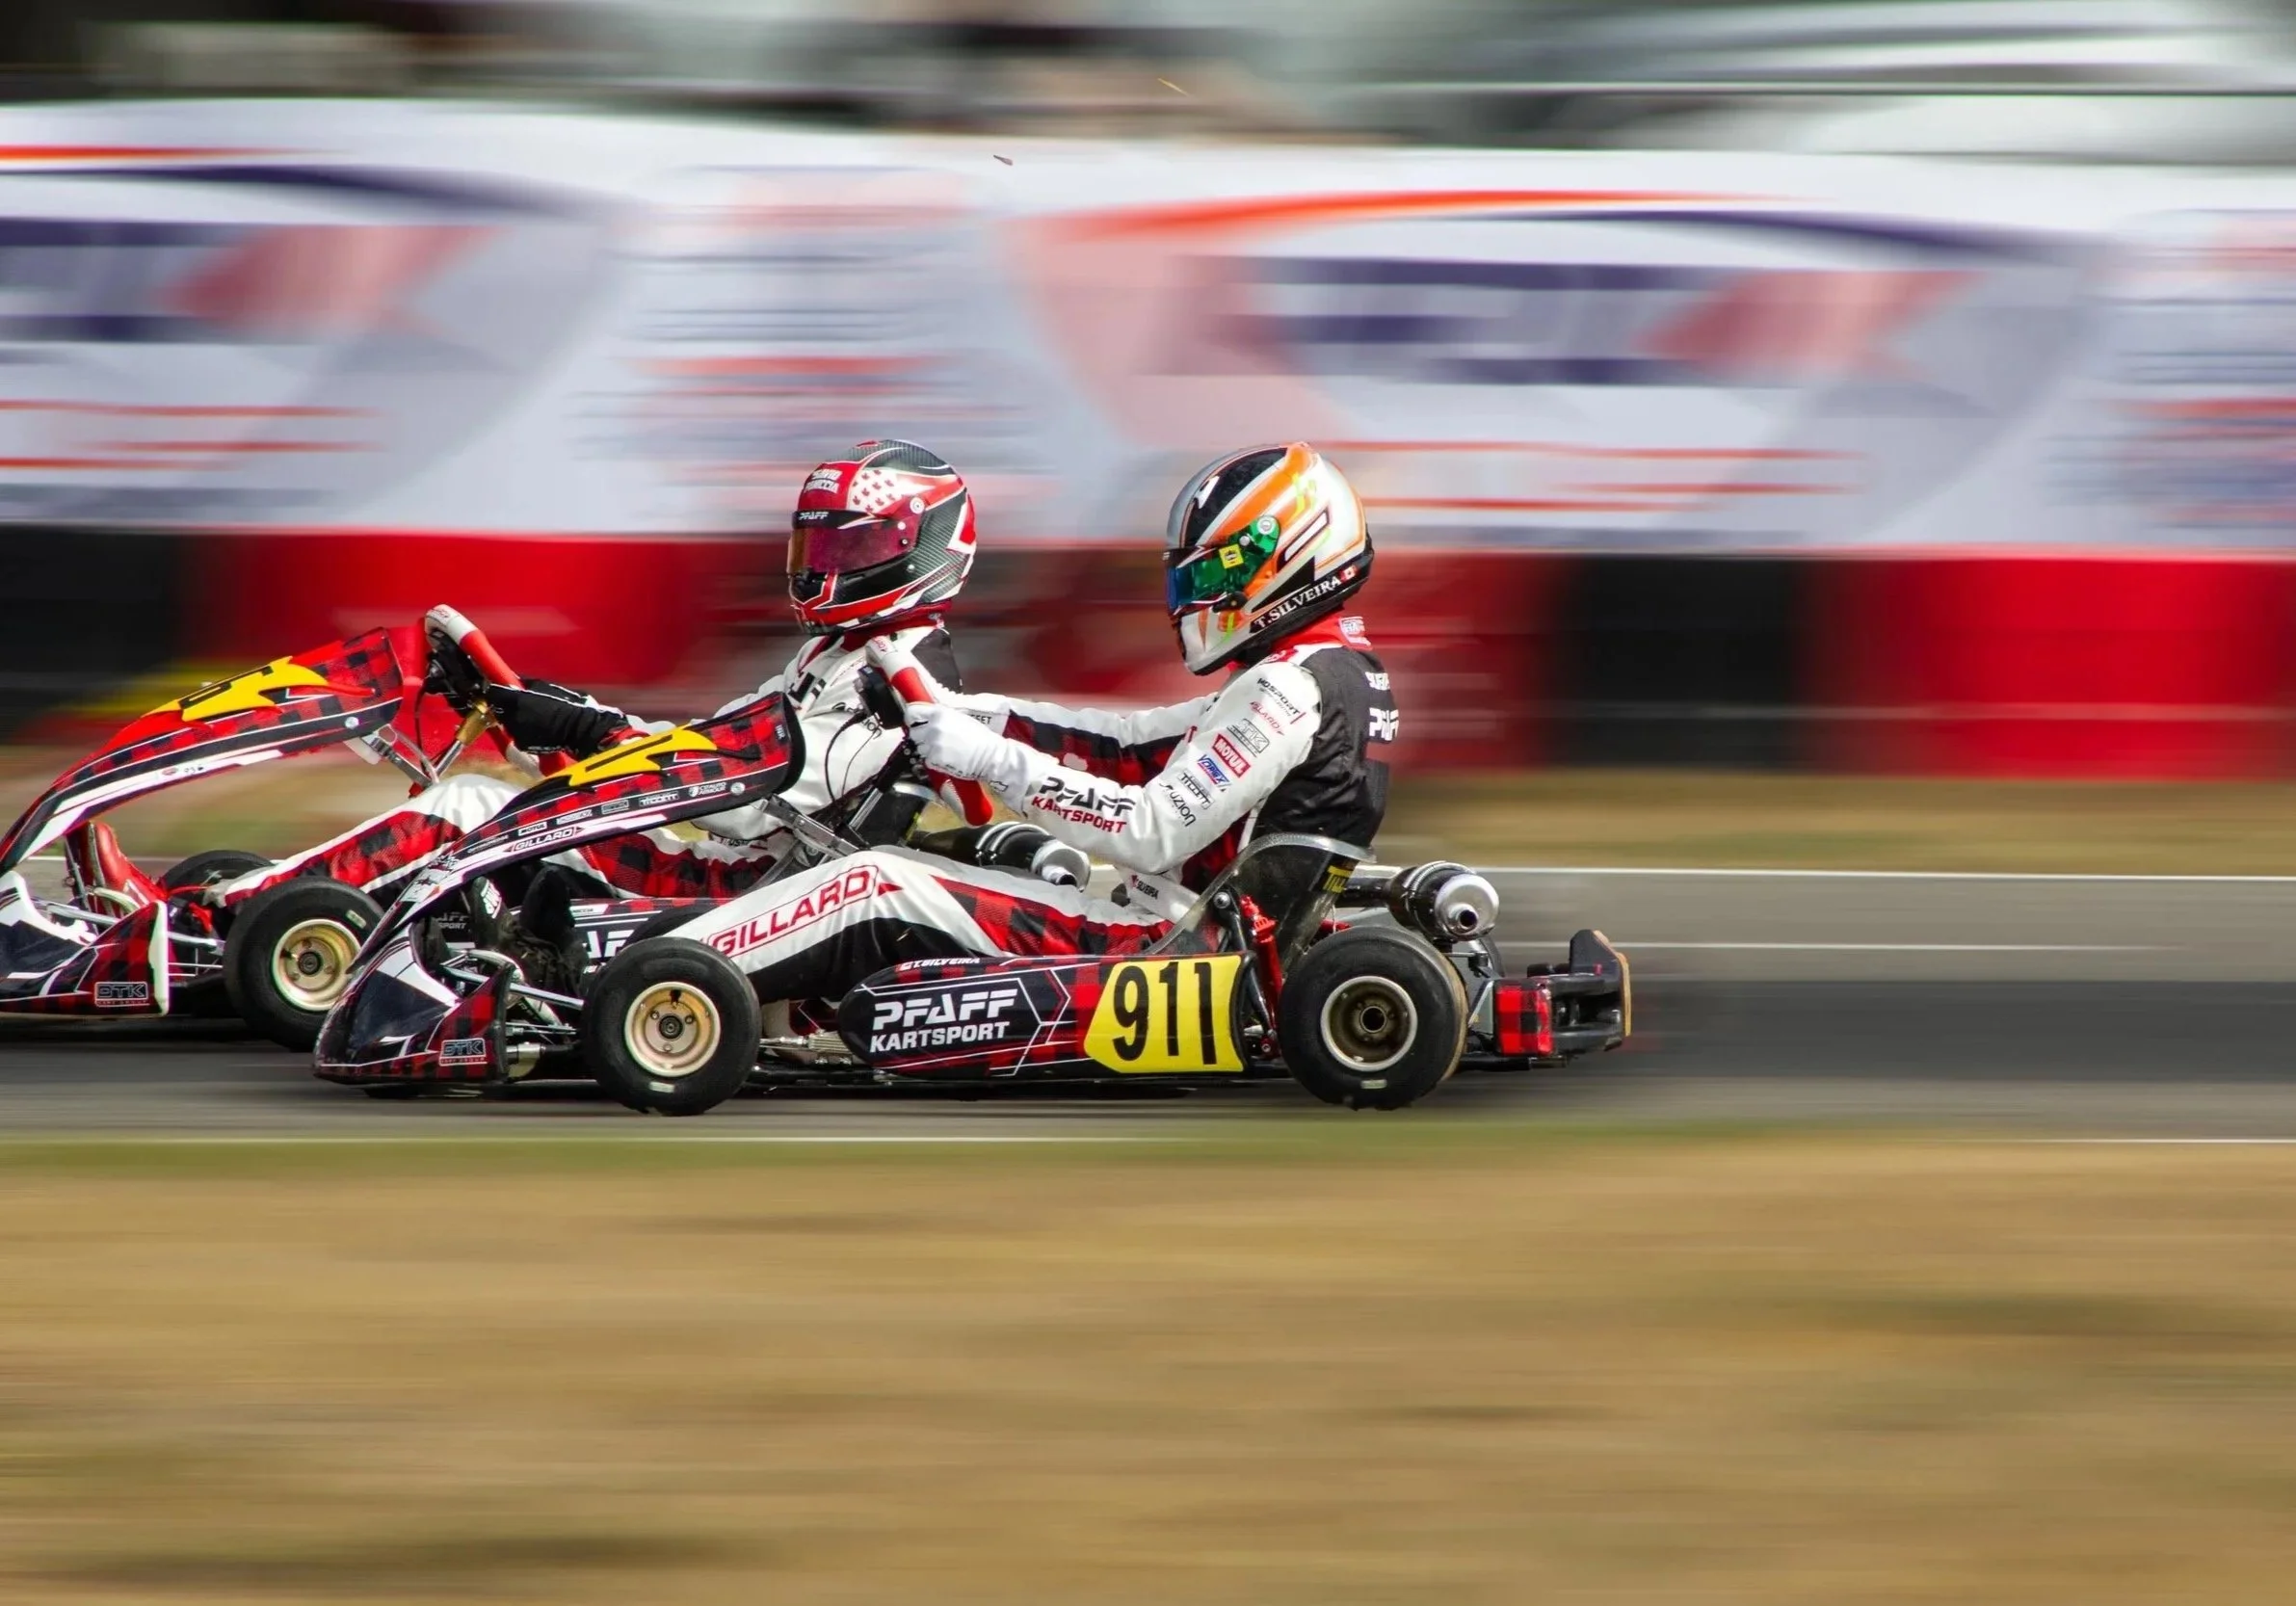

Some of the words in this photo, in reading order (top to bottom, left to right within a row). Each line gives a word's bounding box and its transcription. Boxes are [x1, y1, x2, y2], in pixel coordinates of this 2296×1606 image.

[1254, 575, 1342, 628] T.SILVEIRA
[1215, 740, 1245, 775] MOTUL
[1031, 796, 1127, 834] KARTSPORT
[1039, 776, 1137, 817] PFAFF
[515, 829, 573, 849] GILLARD
[712, 870, 870, 956] GILLARD
[873, 988, 1018, 1031] PFAFF
[1112, 961, 1218, 1066] 911
[870, 1021, 1010, 1053] KARTSPORT
